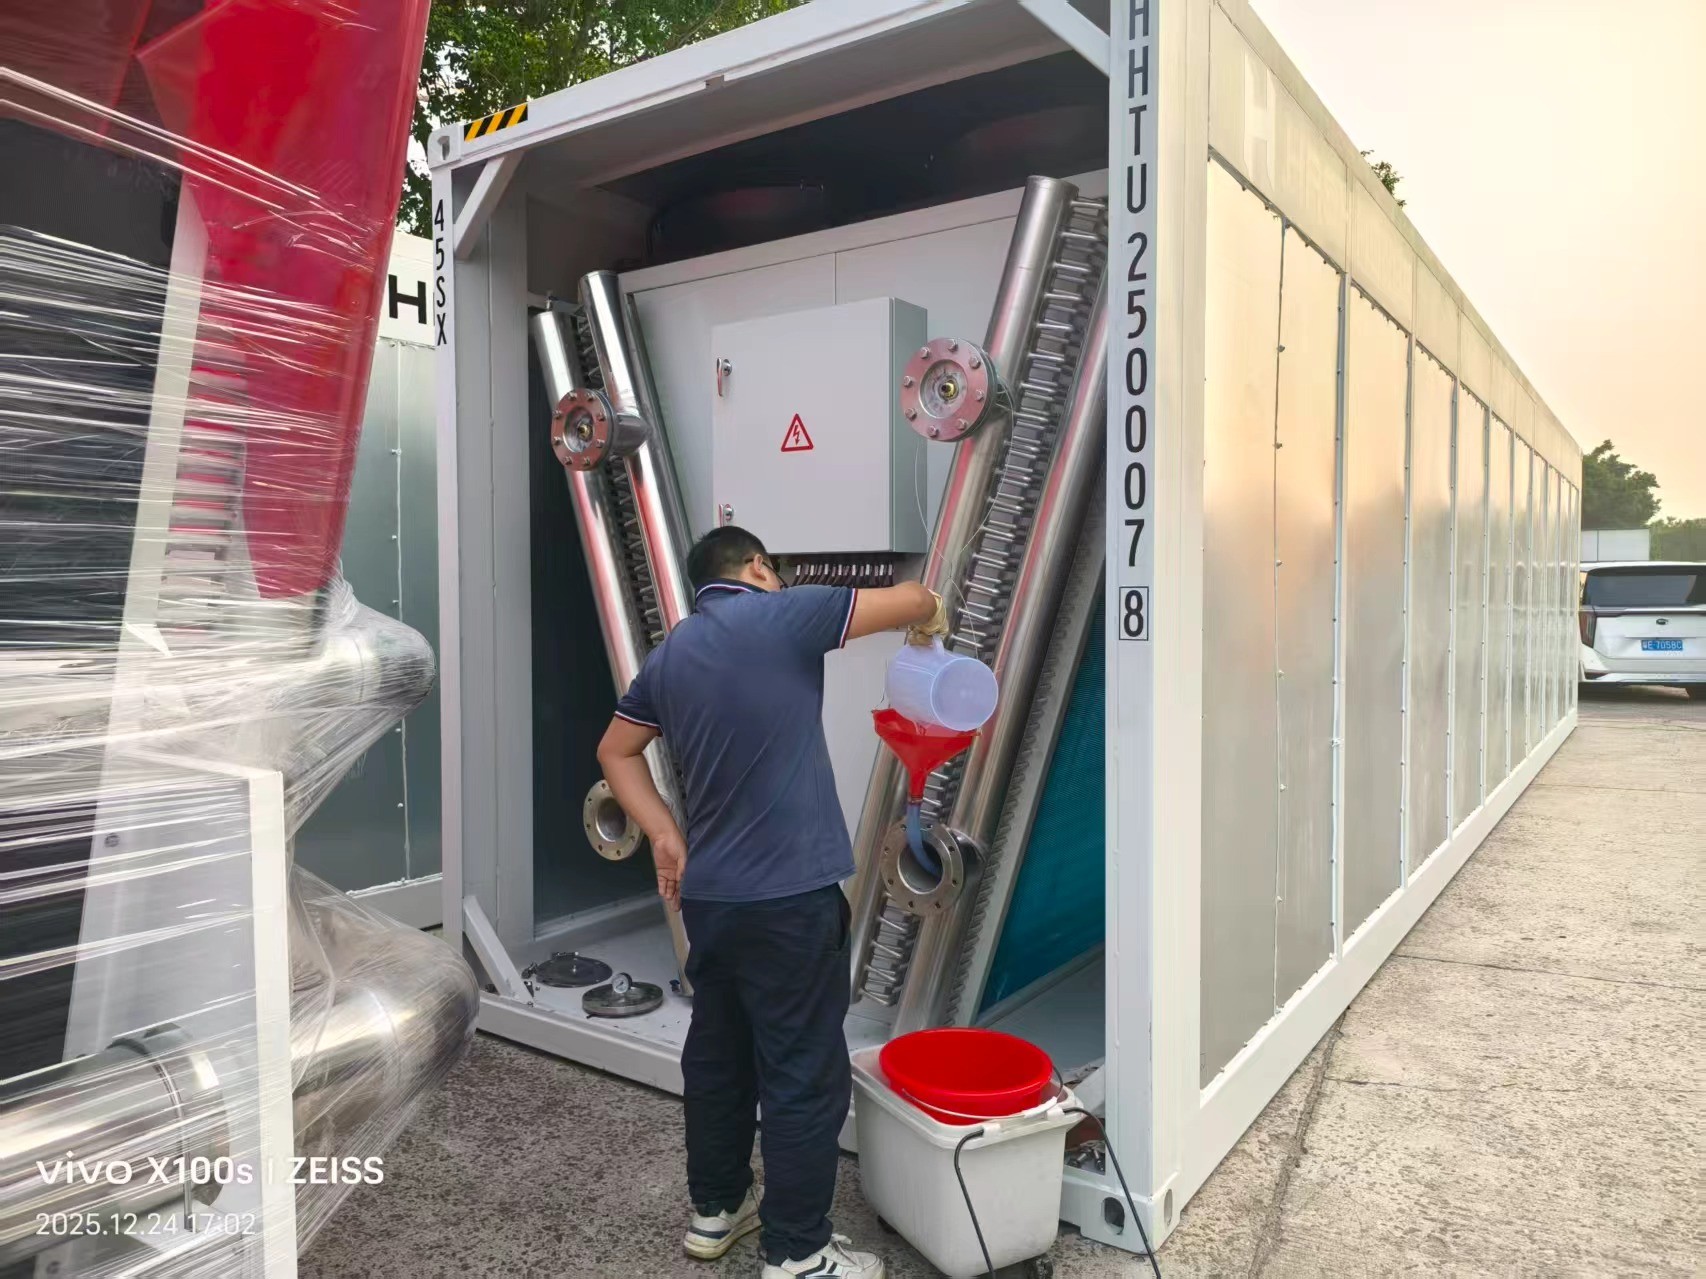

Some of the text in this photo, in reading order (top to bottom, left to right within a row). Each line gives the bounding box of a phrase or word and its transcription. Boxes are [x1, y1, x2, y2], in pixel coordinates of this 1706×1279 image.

[434, 199, 447, 346] 45SX
[1123, 0, 1149, 638] HHTU 250007 8
